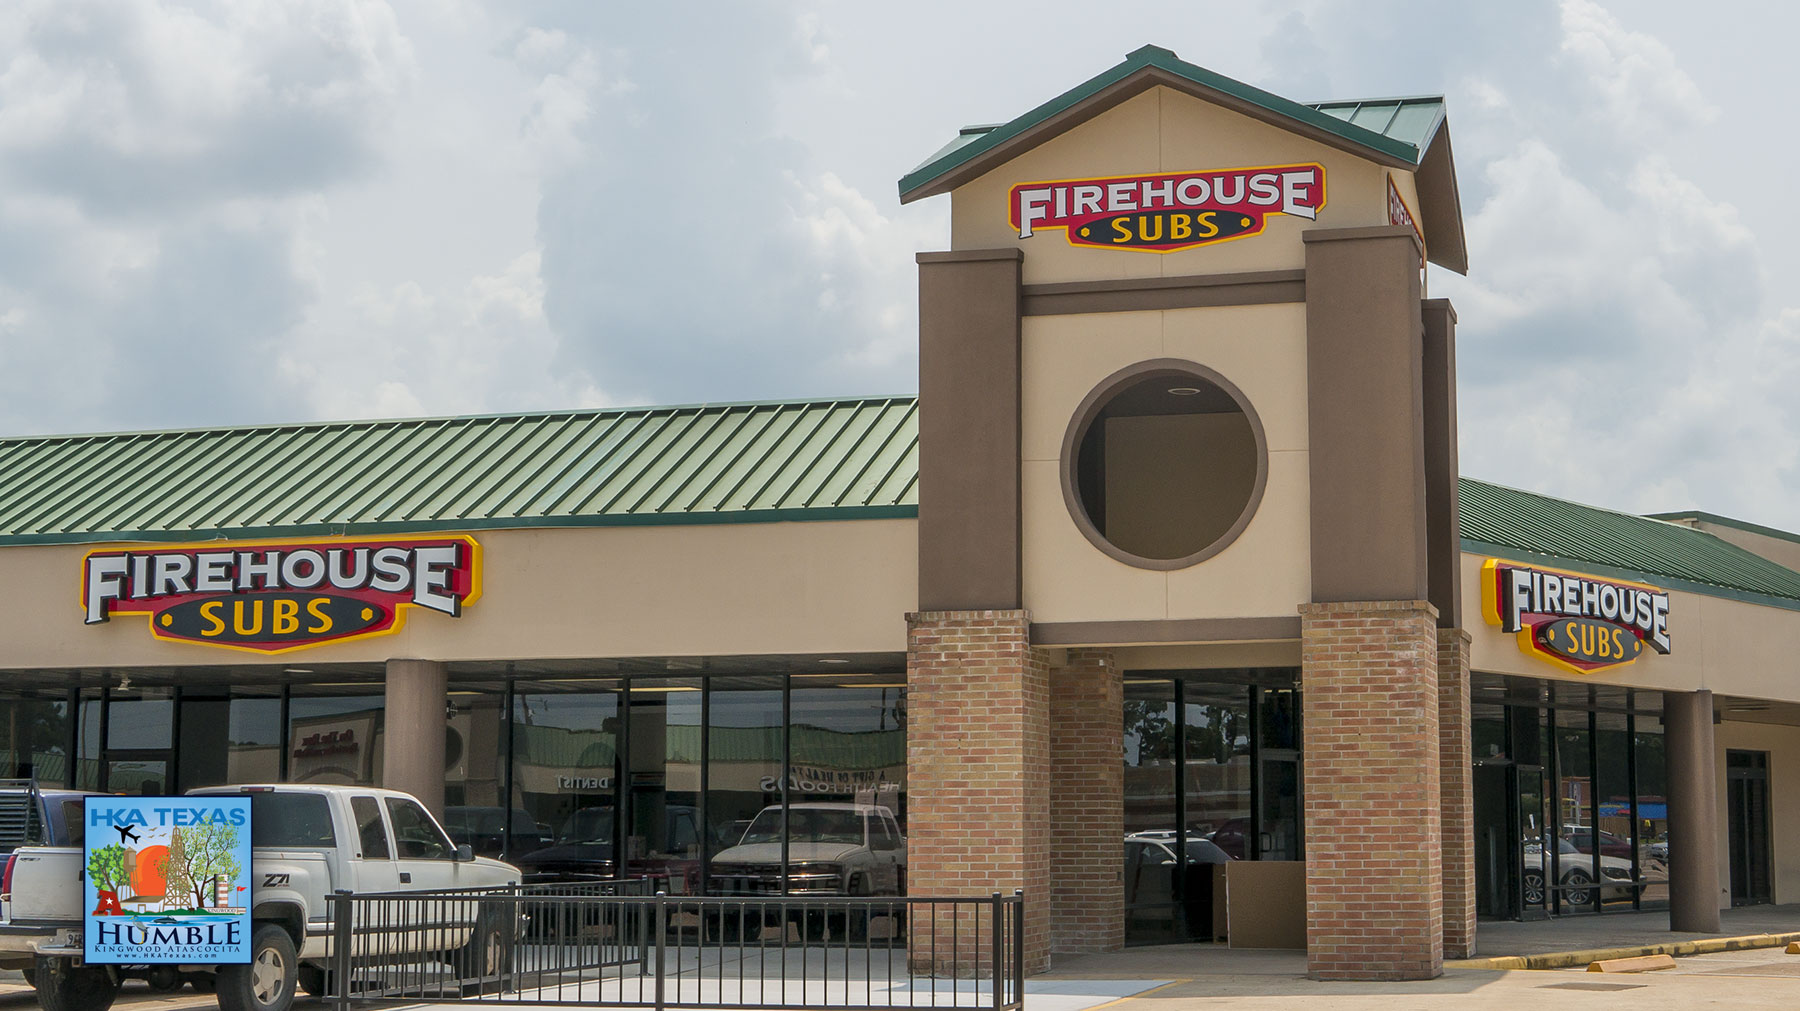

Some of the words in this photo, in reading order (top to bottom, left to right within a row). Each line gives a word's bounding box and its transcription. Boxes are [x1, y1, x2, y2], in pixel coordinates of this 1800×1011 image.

[1019, 169, 1316, 239] FIREHOUSE
[1111, 211, 1220, 243] SUBS
[84, 543, 461, 625] FIREHOUSE
[200, 598, 333, 637] SUBS
[1503, 567, 1671, 654] FIREHOUSE
[1566, 622, 1624, 660] SUBS
[262, 873, 290, 888] Z71
